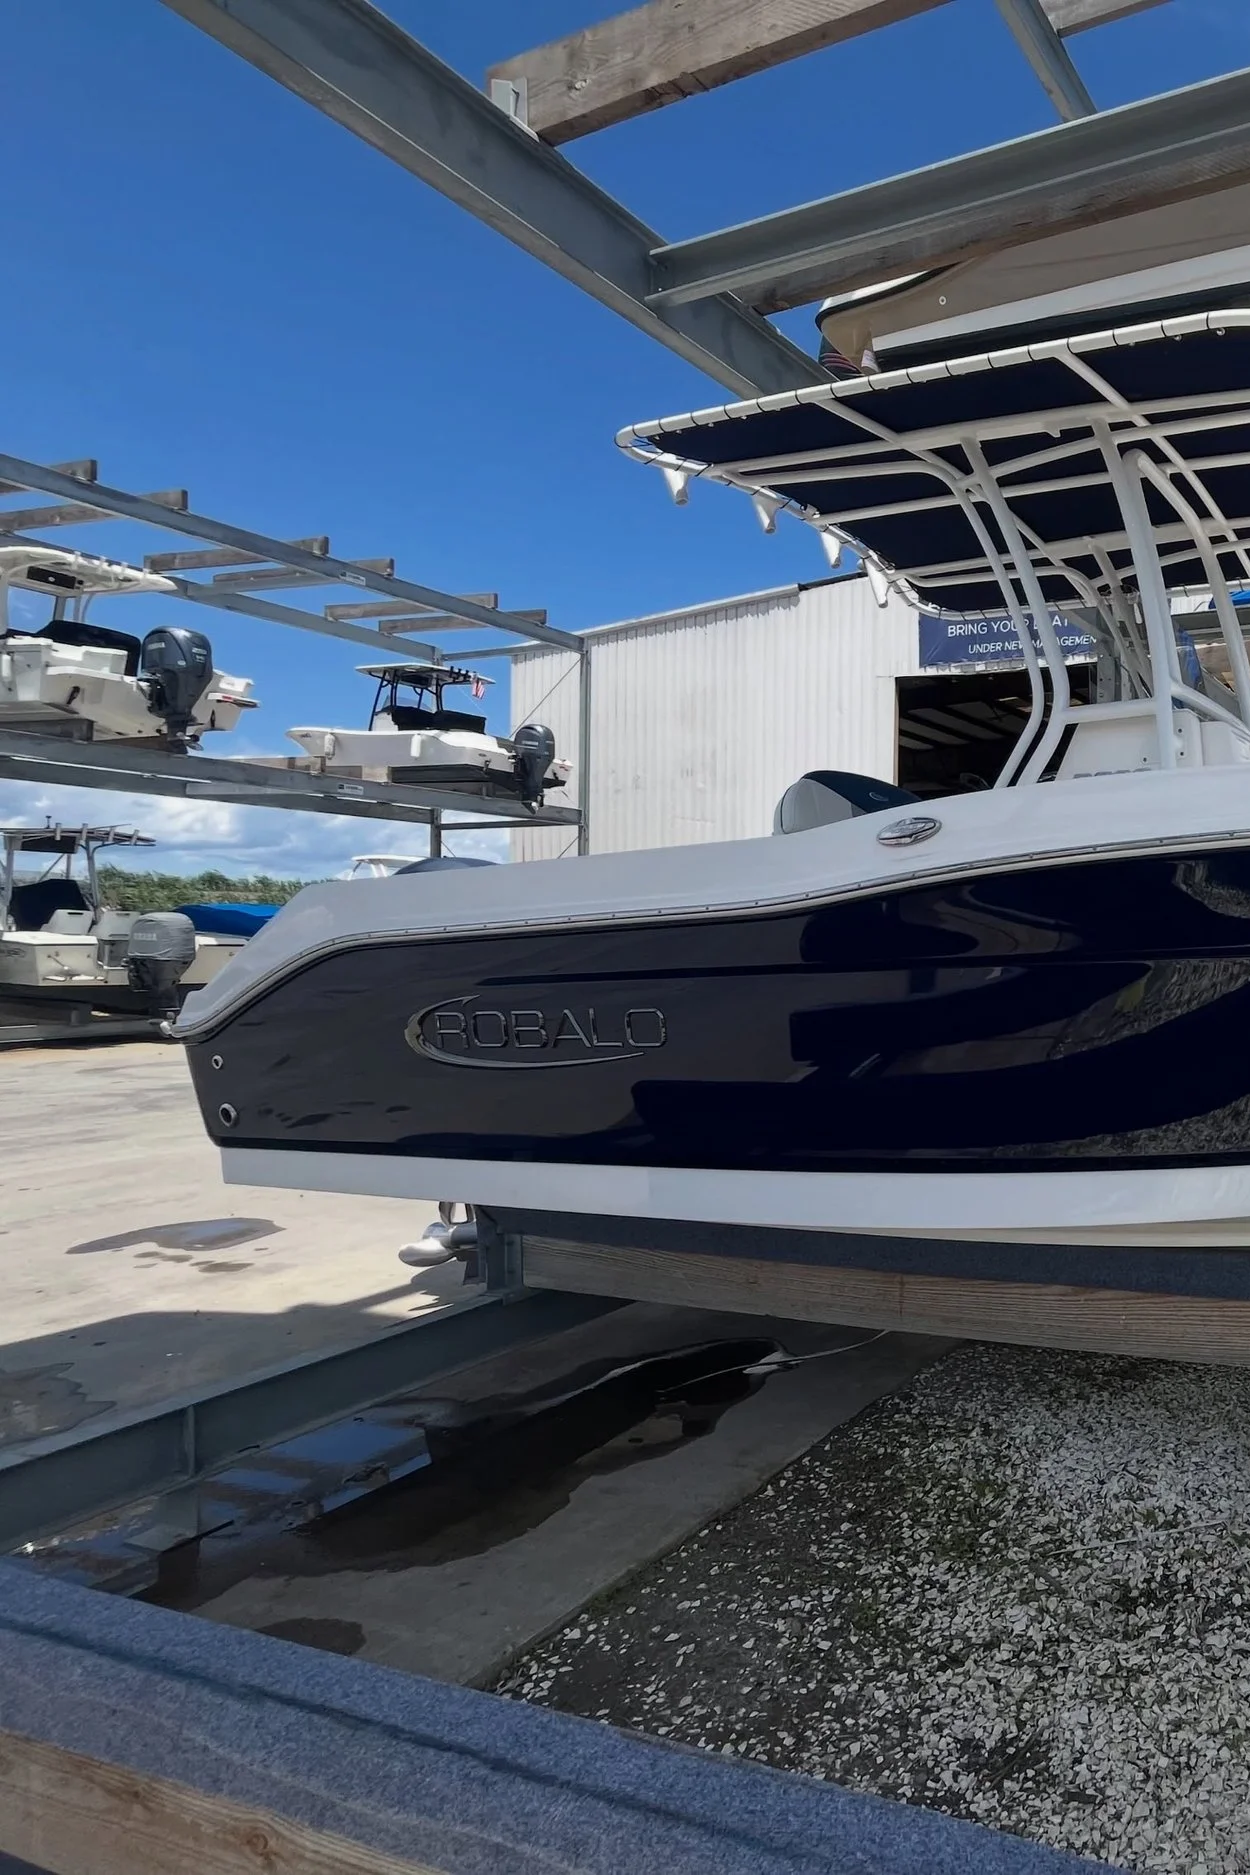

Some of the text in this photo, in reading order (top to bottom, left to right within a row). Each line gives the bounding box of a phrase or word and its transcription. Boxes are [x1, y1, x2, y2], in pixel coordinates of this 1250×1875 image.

[947, 621, 988, 638] BRING
[968, 641, 1002, 654] UNDER
[434, 1007, 668, 1049] ROBALO
